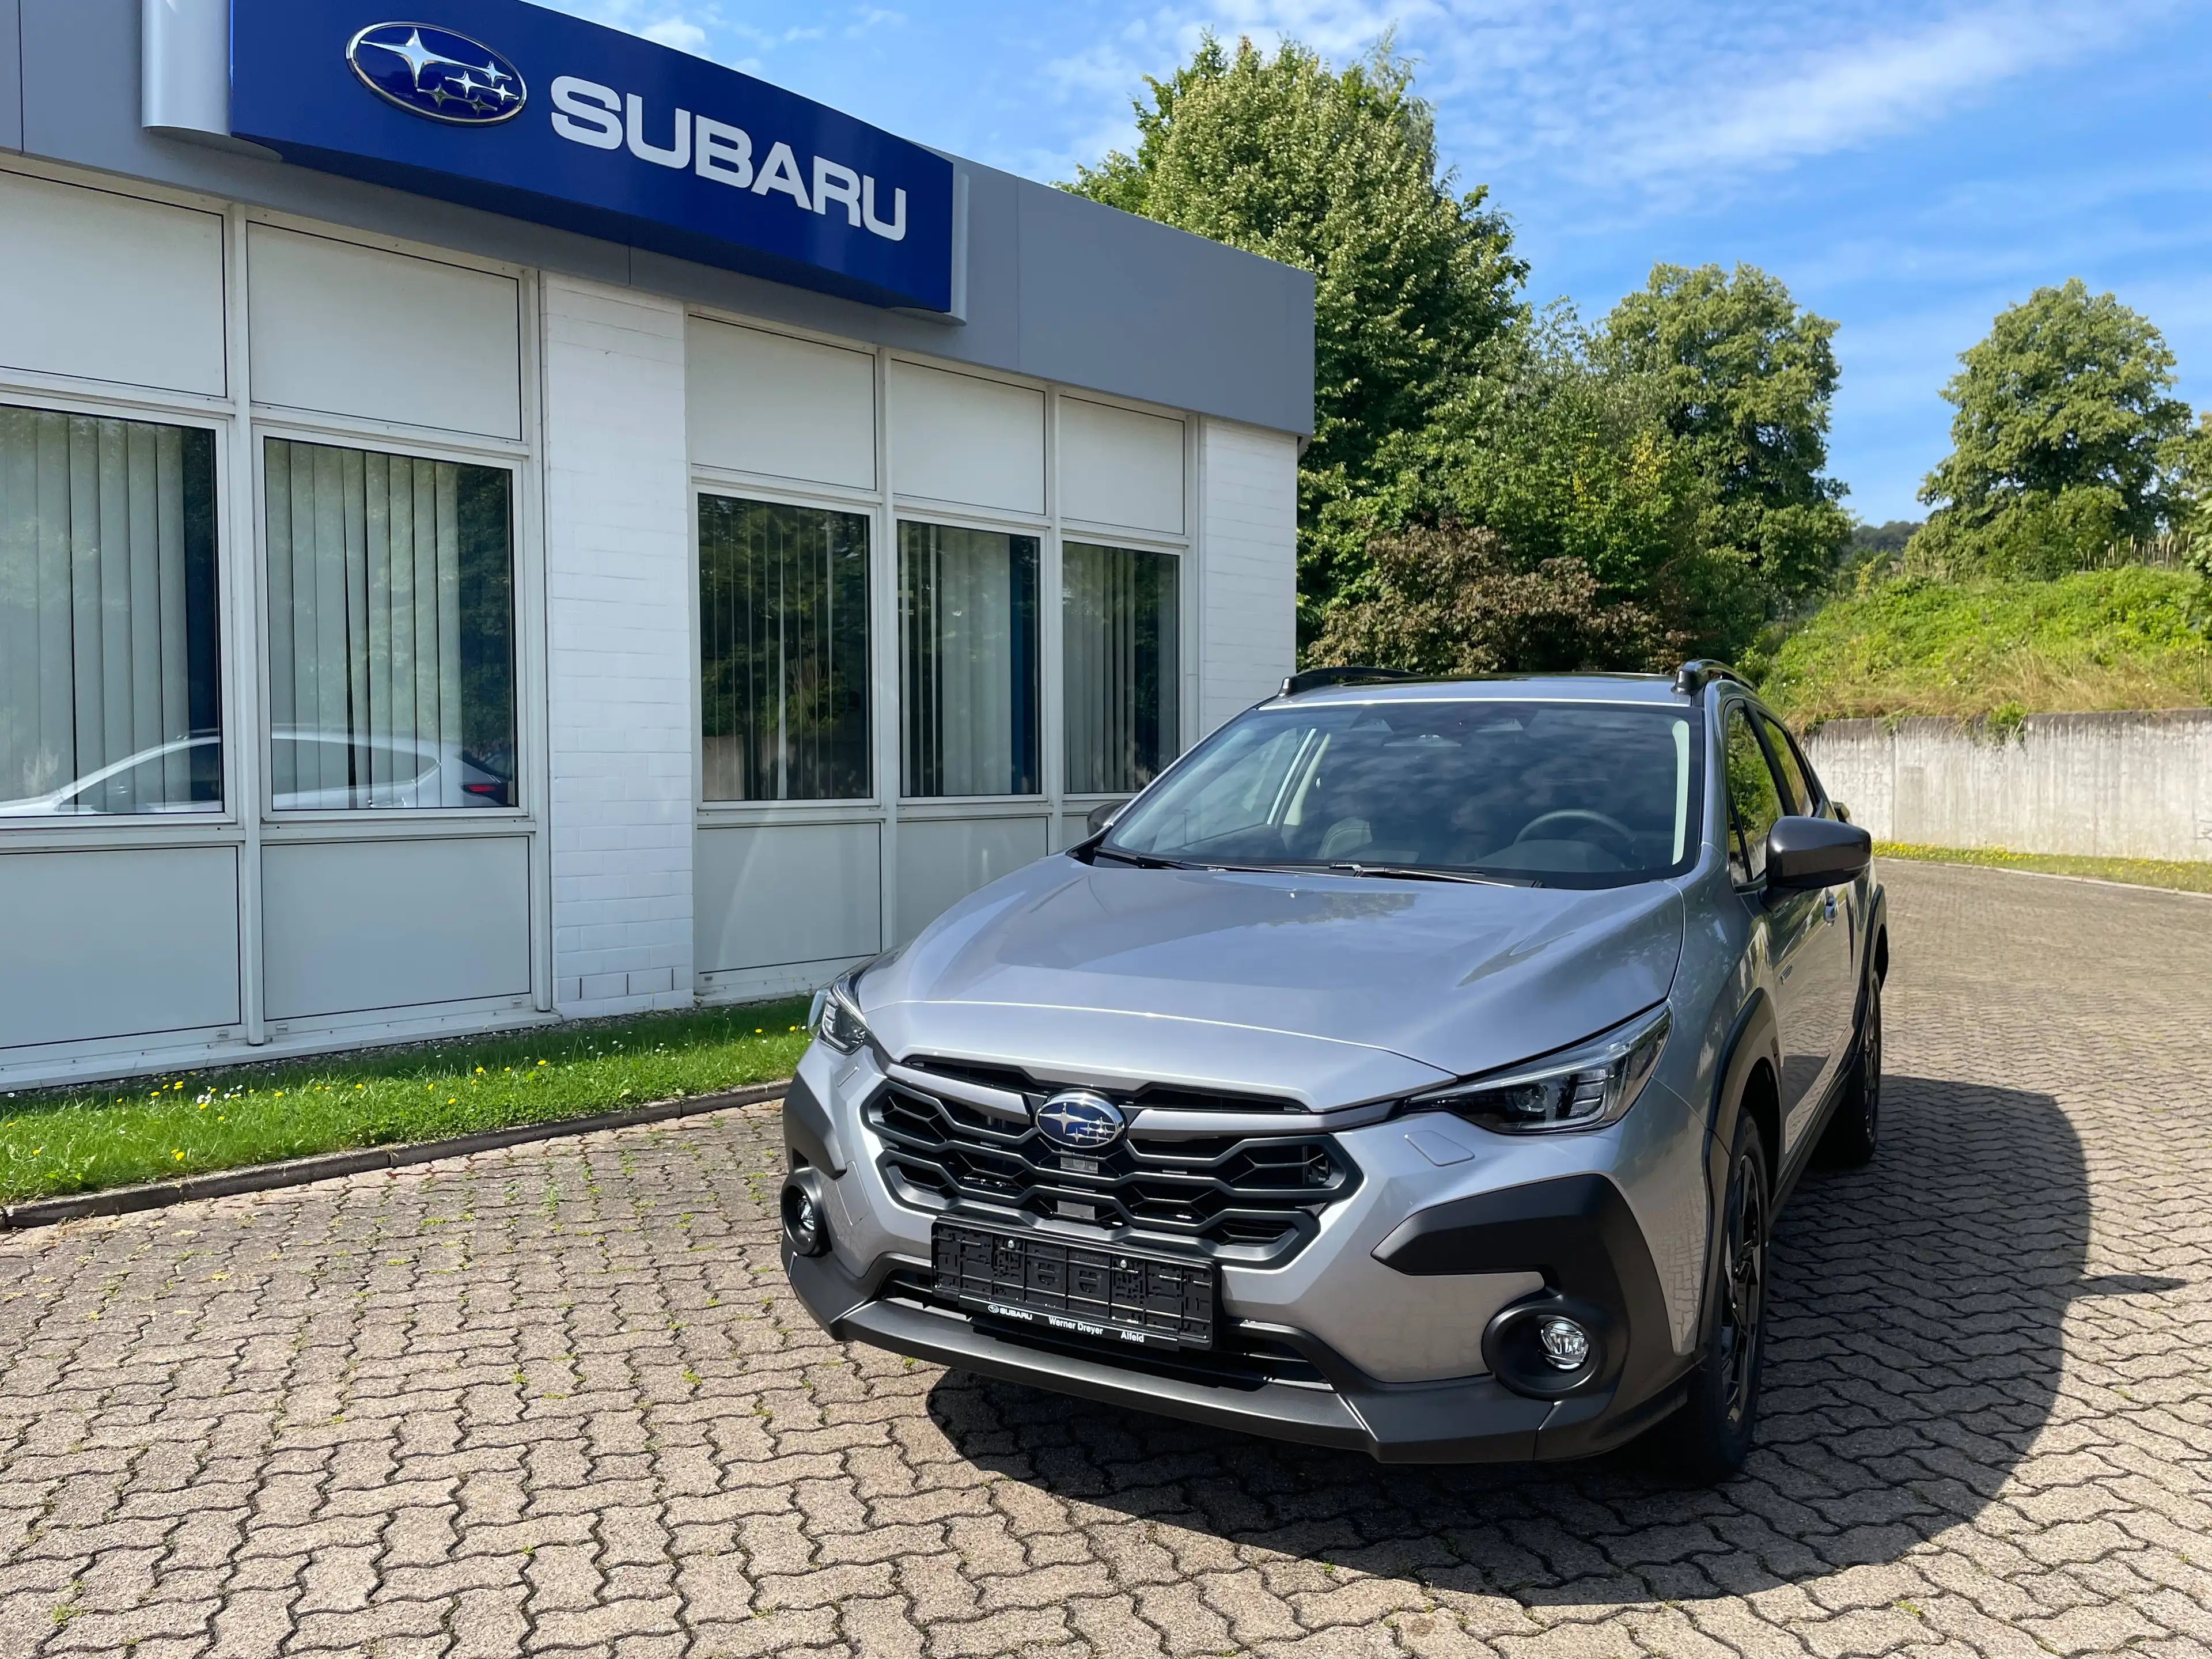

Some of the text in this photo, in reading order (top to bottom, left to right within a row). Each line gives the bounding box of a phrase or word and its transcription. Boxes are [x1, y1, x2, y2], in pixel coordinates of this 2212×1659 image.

[551, 75, 906, 241] SUBARU
[999, 1307, 1145, 1343] SUBARU Werner Dreyer Alfeld
